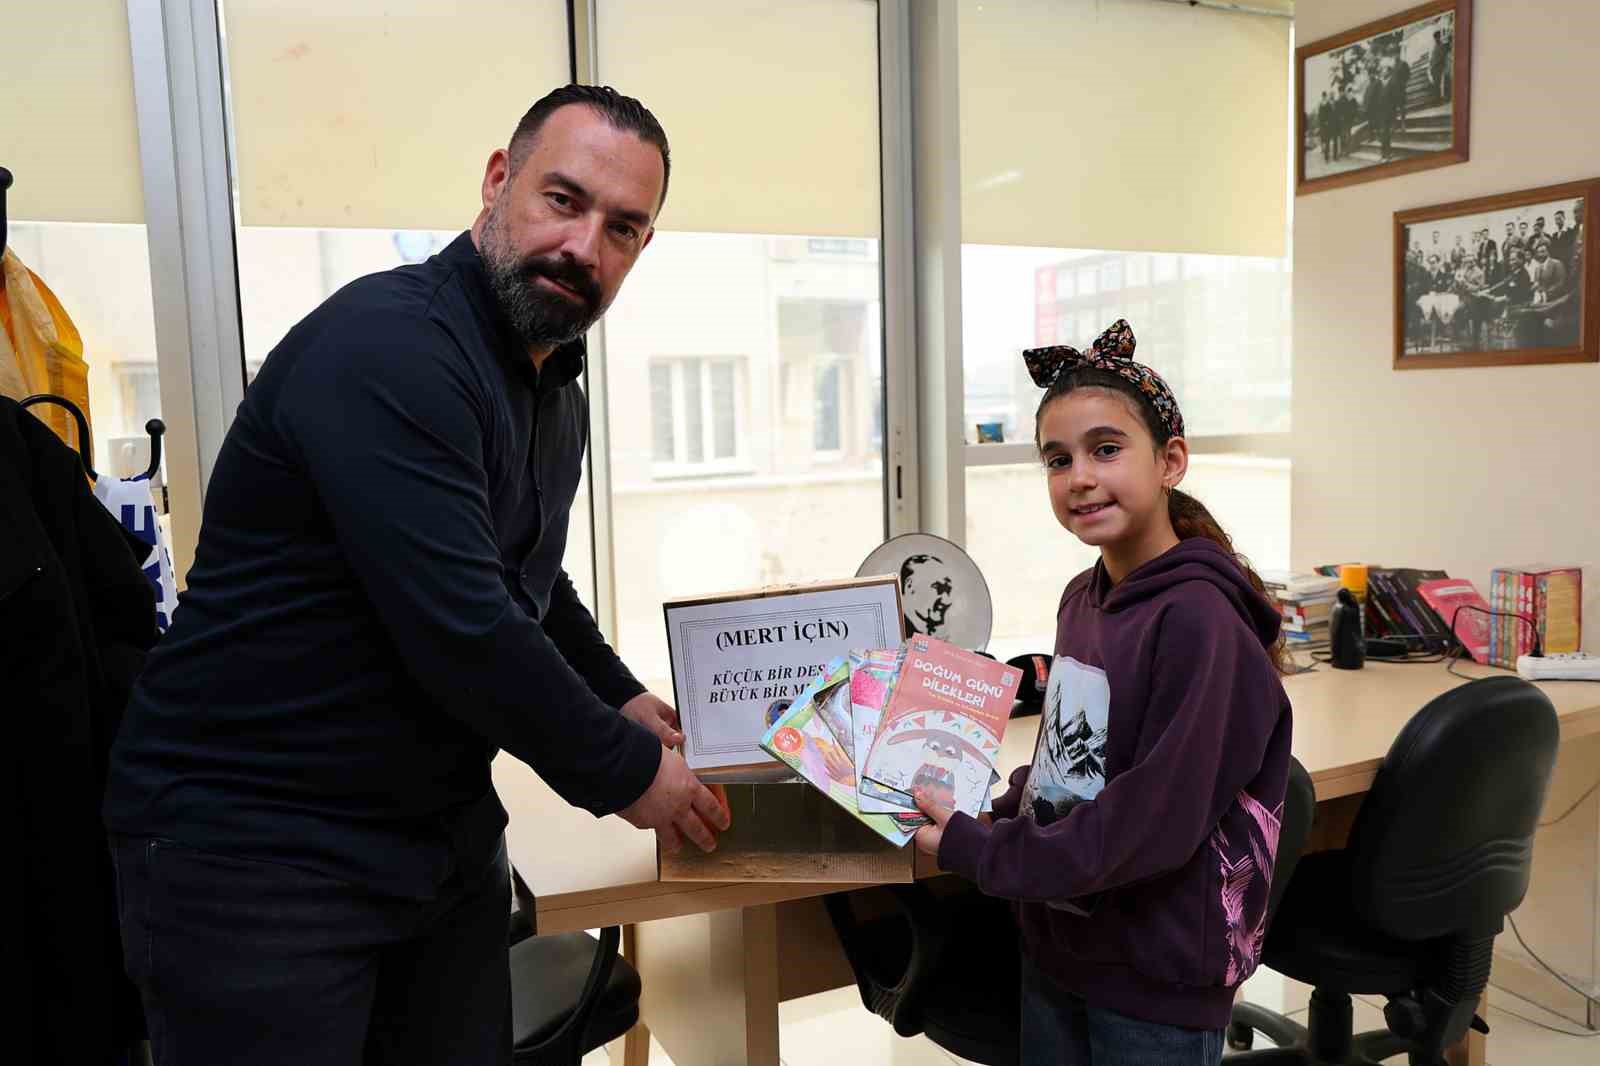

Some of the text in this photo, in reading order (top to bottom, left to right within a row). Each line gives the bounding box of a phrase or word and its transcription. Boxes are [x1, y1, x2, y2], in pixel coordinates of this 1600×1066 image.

[716, 618, 848, 651] (MERT İÇİN)
[713, 669, 763, 686] KÜÇÜK
[768, 665, 792, 680] BİR
[913, 659, 1003, 698] DOĞUM GÜNÜ
[709, 688, 759, 703] BÜYÜK
[763, 683, 788, 698] BİR
[922, 677, 985, 707] DİLEKLERİ
